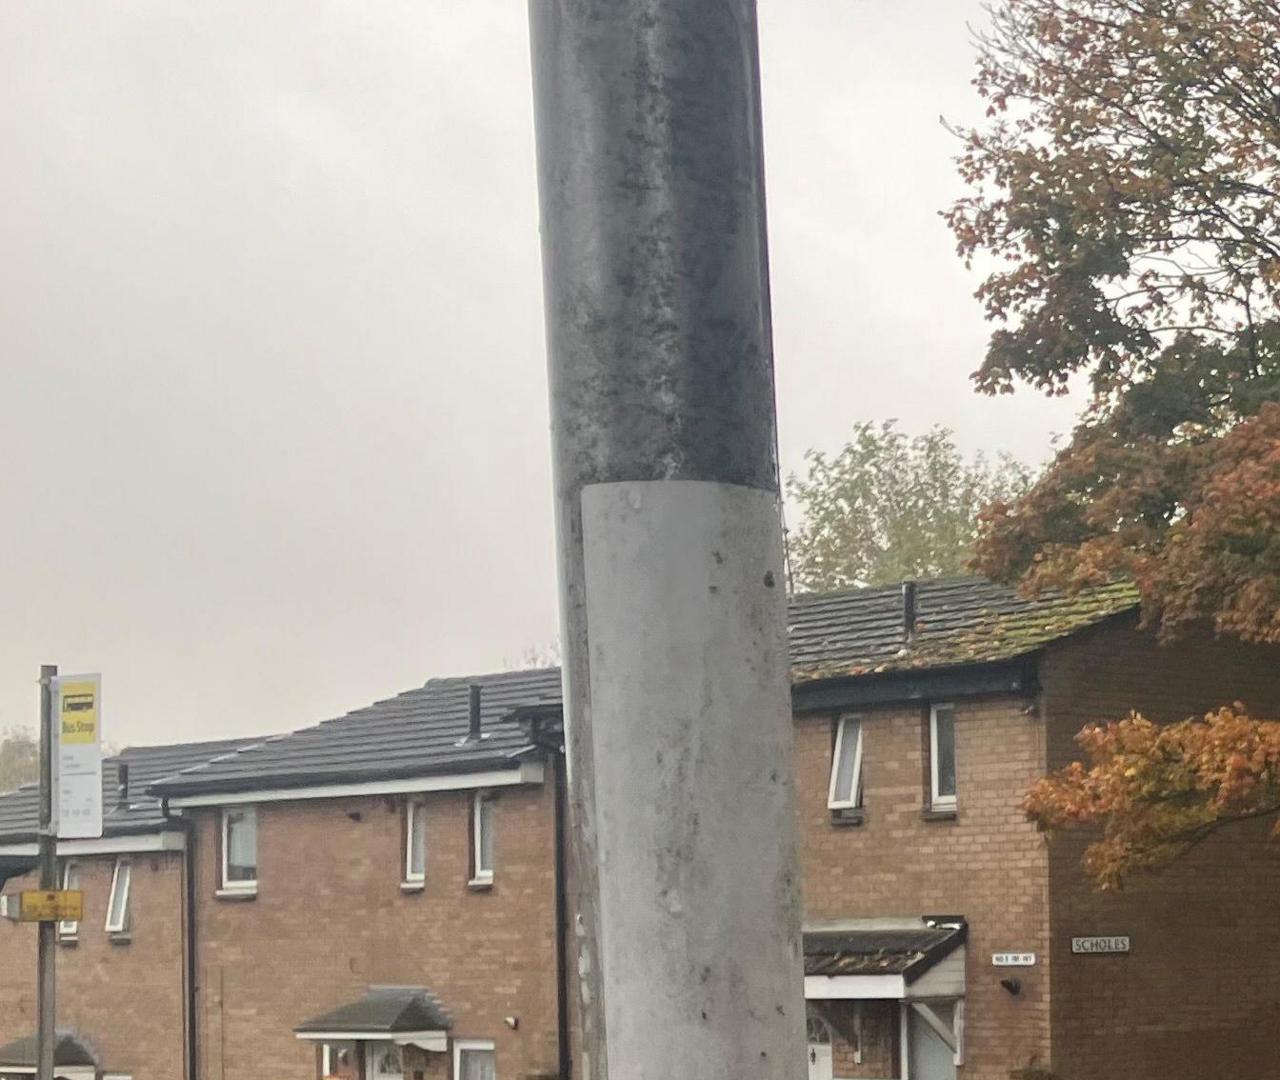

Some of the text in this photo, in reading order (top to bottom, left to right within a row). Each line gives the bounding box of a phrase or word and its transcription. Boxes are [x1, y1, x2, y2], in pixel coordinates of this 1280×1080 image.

[62, 720, 94, 735] Bus Stop
[1075, 938, 1128, 951] SCHOLES
